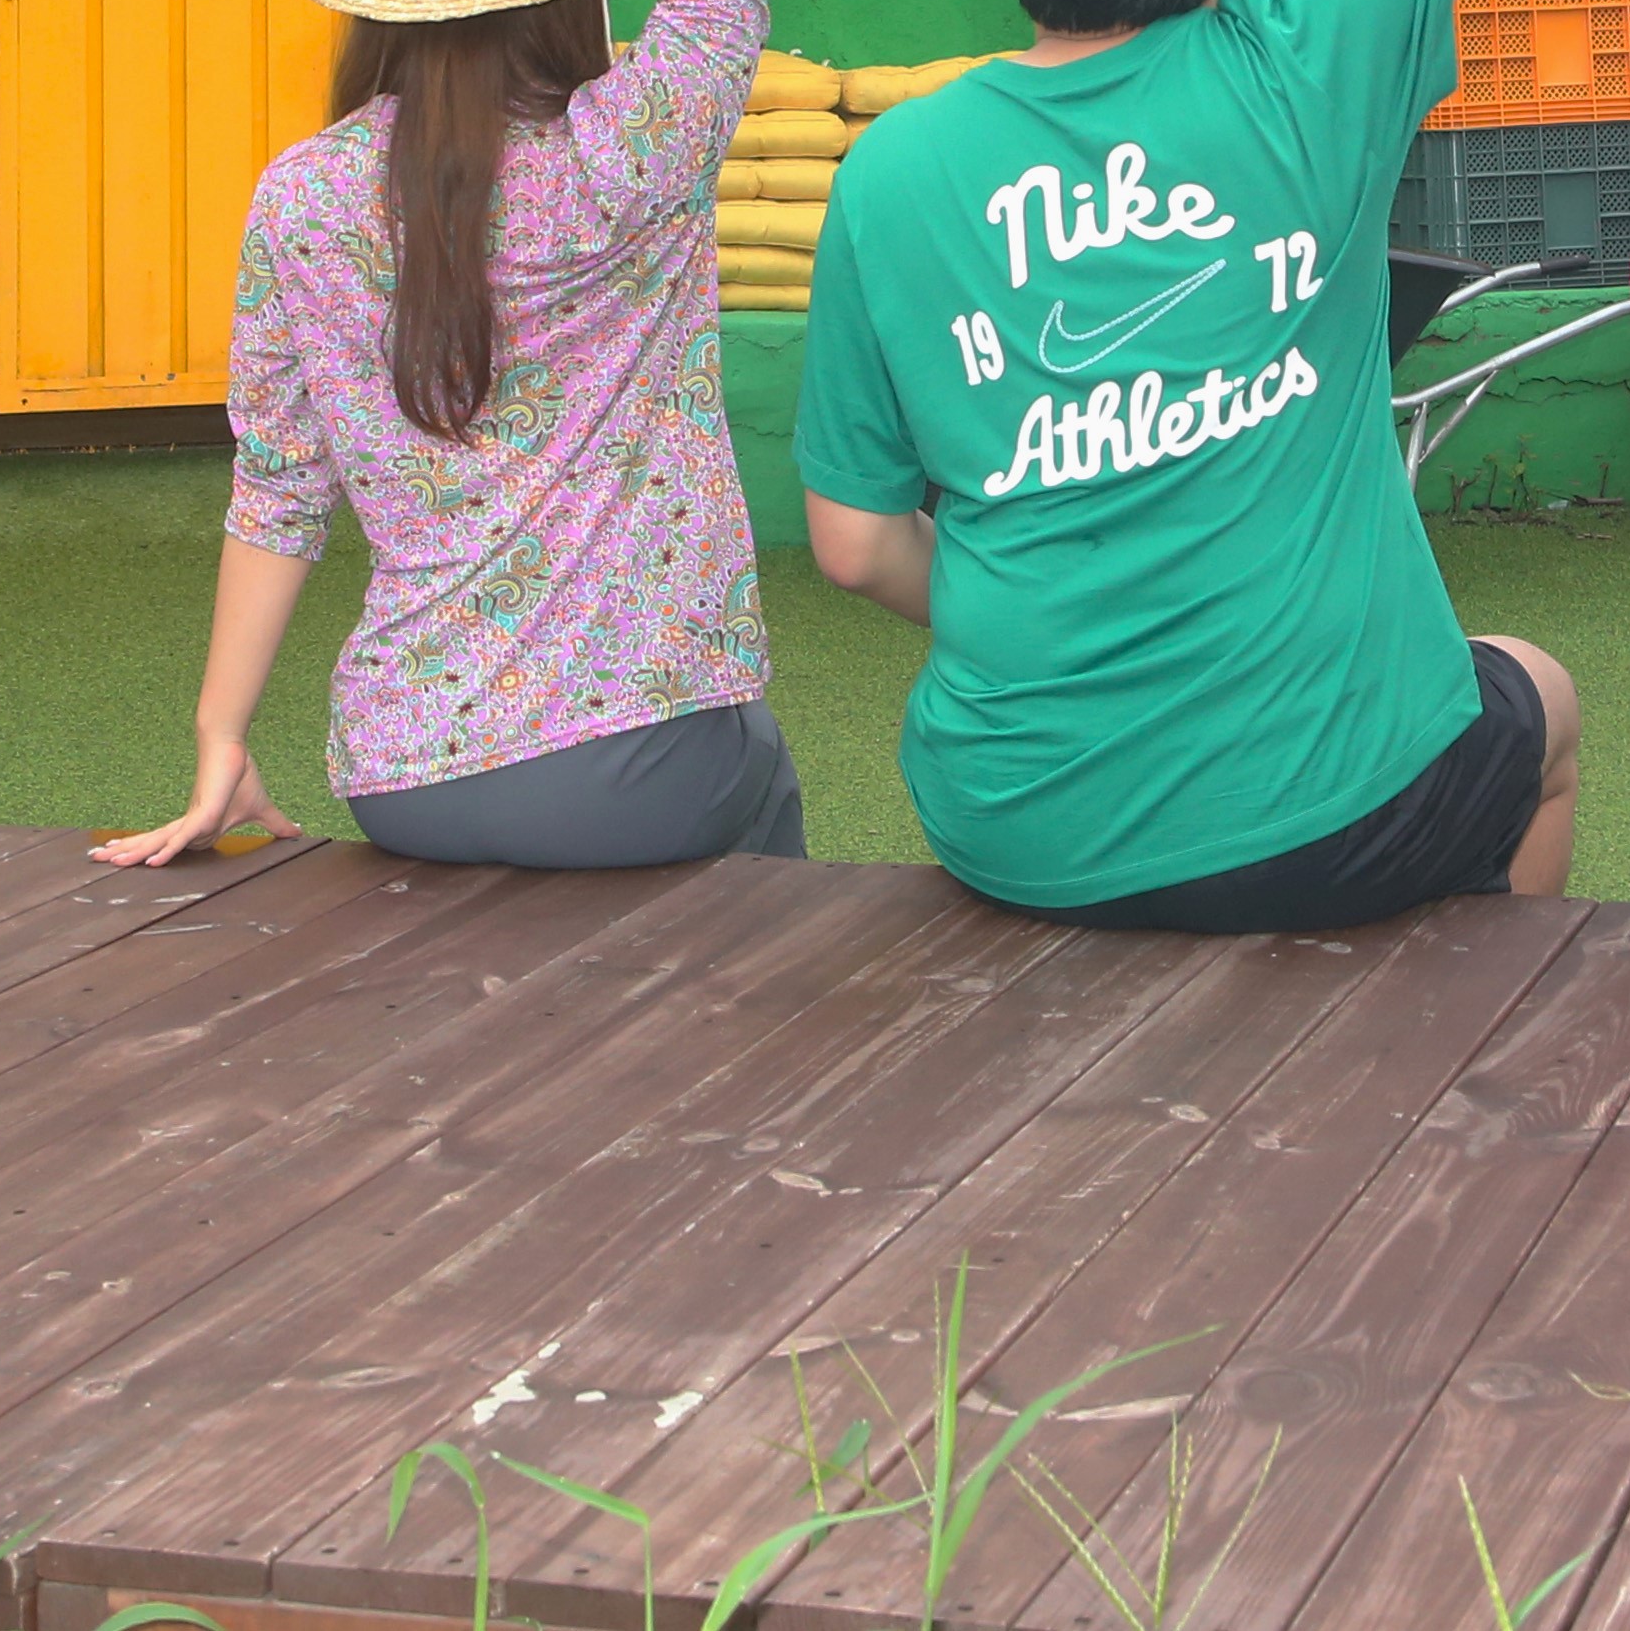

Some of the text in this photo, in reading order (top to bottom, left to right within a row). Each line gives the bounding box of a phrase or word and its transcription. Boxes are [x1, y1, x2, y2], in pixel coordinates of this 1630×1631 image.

[986, 142, 1235, 288] Nike
[951, 231, 1323, 386] 19 72
[983, 347, 1318, 496] Athletics
